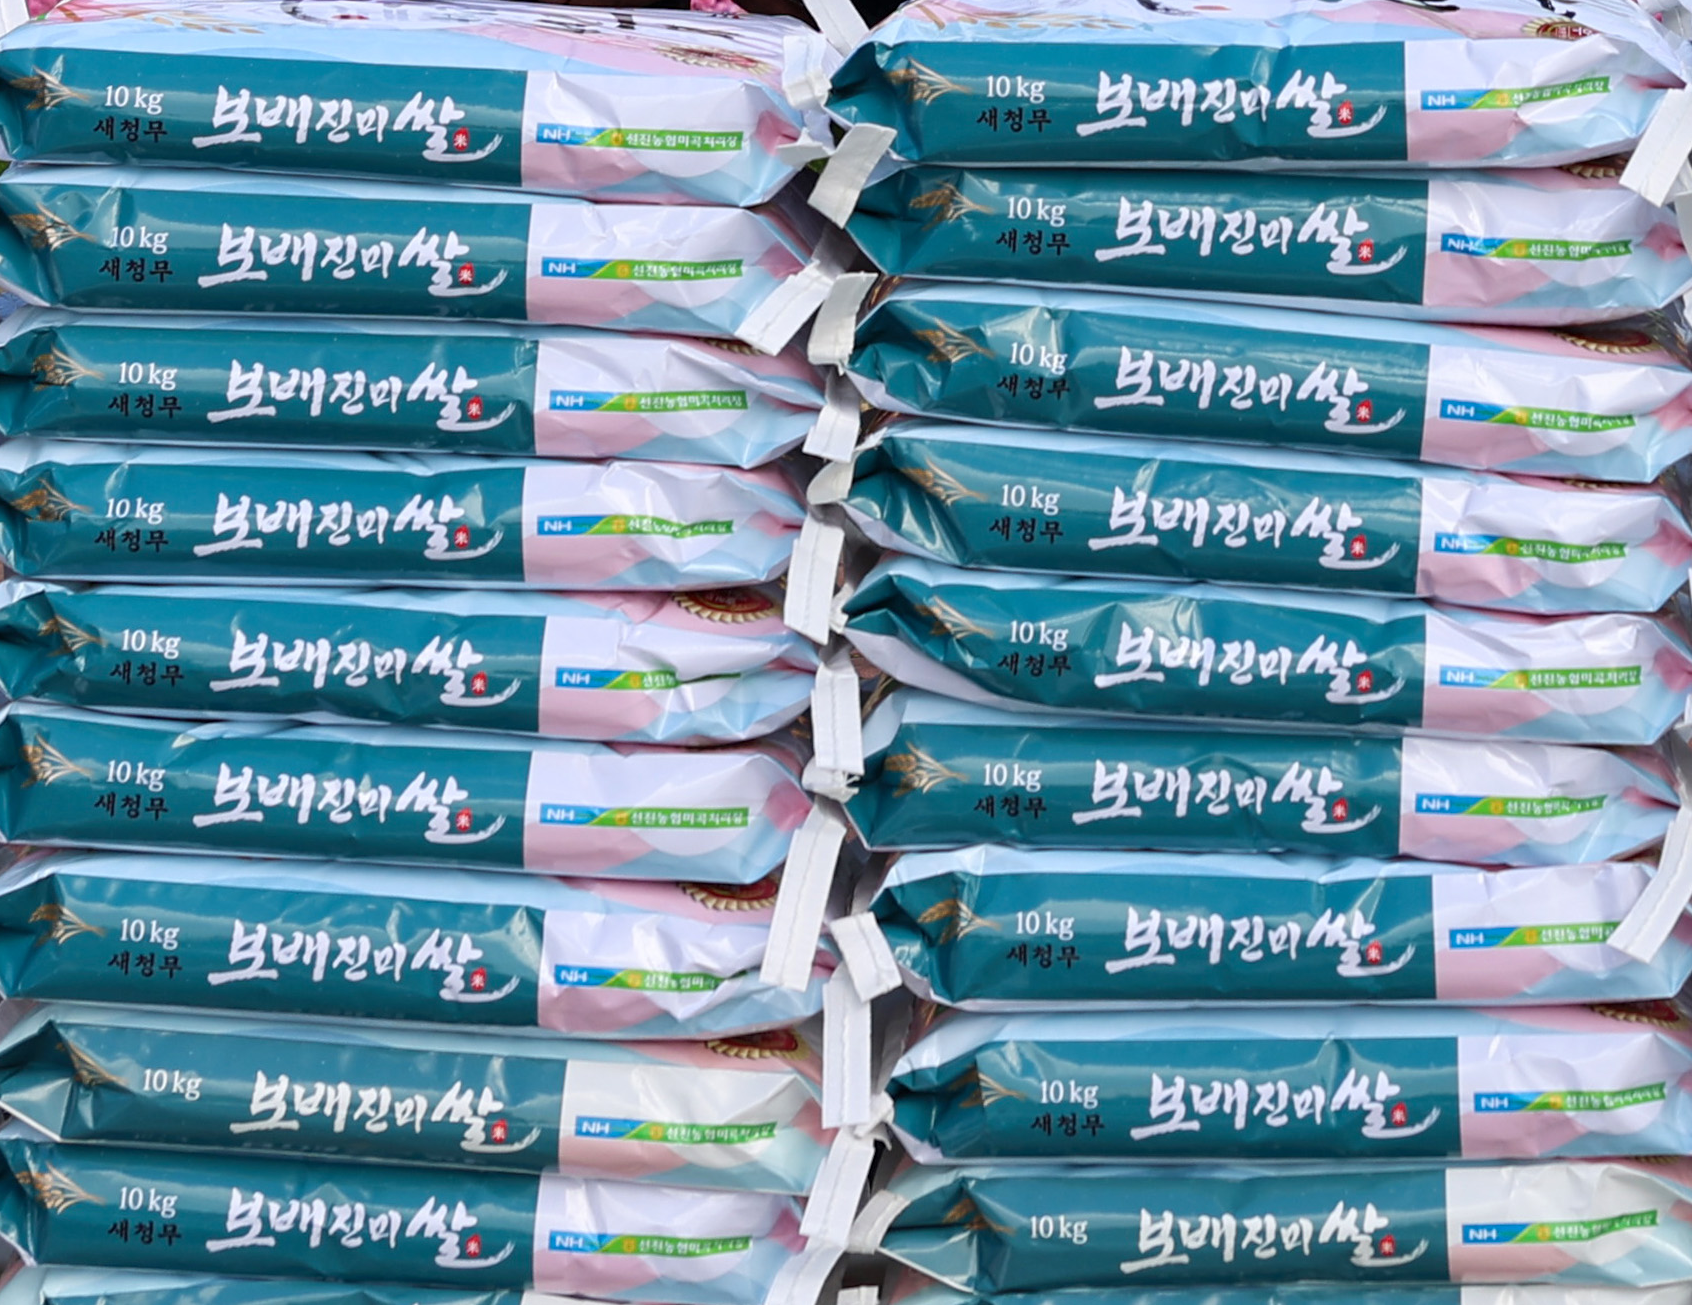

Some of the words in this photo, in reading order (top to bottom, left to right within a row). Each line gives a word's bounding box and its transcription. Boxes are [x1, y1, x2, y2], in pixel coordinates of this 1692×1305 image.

[93, 117, 167, 144] 새청무
[193, 85, 502, 160] 보배진미쌀
[542, 127, 572, 141] NH
[976, 107, 1052, 132] 새청무
[1076, 71, 1386, 138] 보배진미쌀
[1428, 94, 1458, 109] NH
[100, 255, 174, 283] 새청무
[198, 225, 506, 297] 보배진미쌀
[995, 230, 1070, 255] 새청무
[1095, 198, 1406, 275] 보배진미쌀
[207, 361, 516, 431] 보배진미쌀
[1095, 348, 1406, 434] 보배진미쌀
[193, 494, 502, 559] 보배진미쌀
[1088, 487, 1399, 569] 보배진미쌀
[210, 630, 519, 707] 보배진미쌀
[997, 650, 1072, 677] 새청무
[1094, 623, 1404, 703] 보배진미쌀
[1446, 670, 1475, 684] NH
[94, 794, 168, 819] 새청무
[194, 765, 504, 844] 보배진미쌀
[1072, 761, 1381, 833] 보배진미쌀
[209, 921, 517, 1001] 보배진미쌀
[1105, 907, 1415, 977] 보배진미쌀
[231, 1072, 540, 1151] 보배진미쌀
[1130, 1073, 1439, 1138] 보배진미쌀
[206, 1188, 513, 1266] 보배진미쌀
[1120, 1201, 1427, 1269] 보배진미쌀
